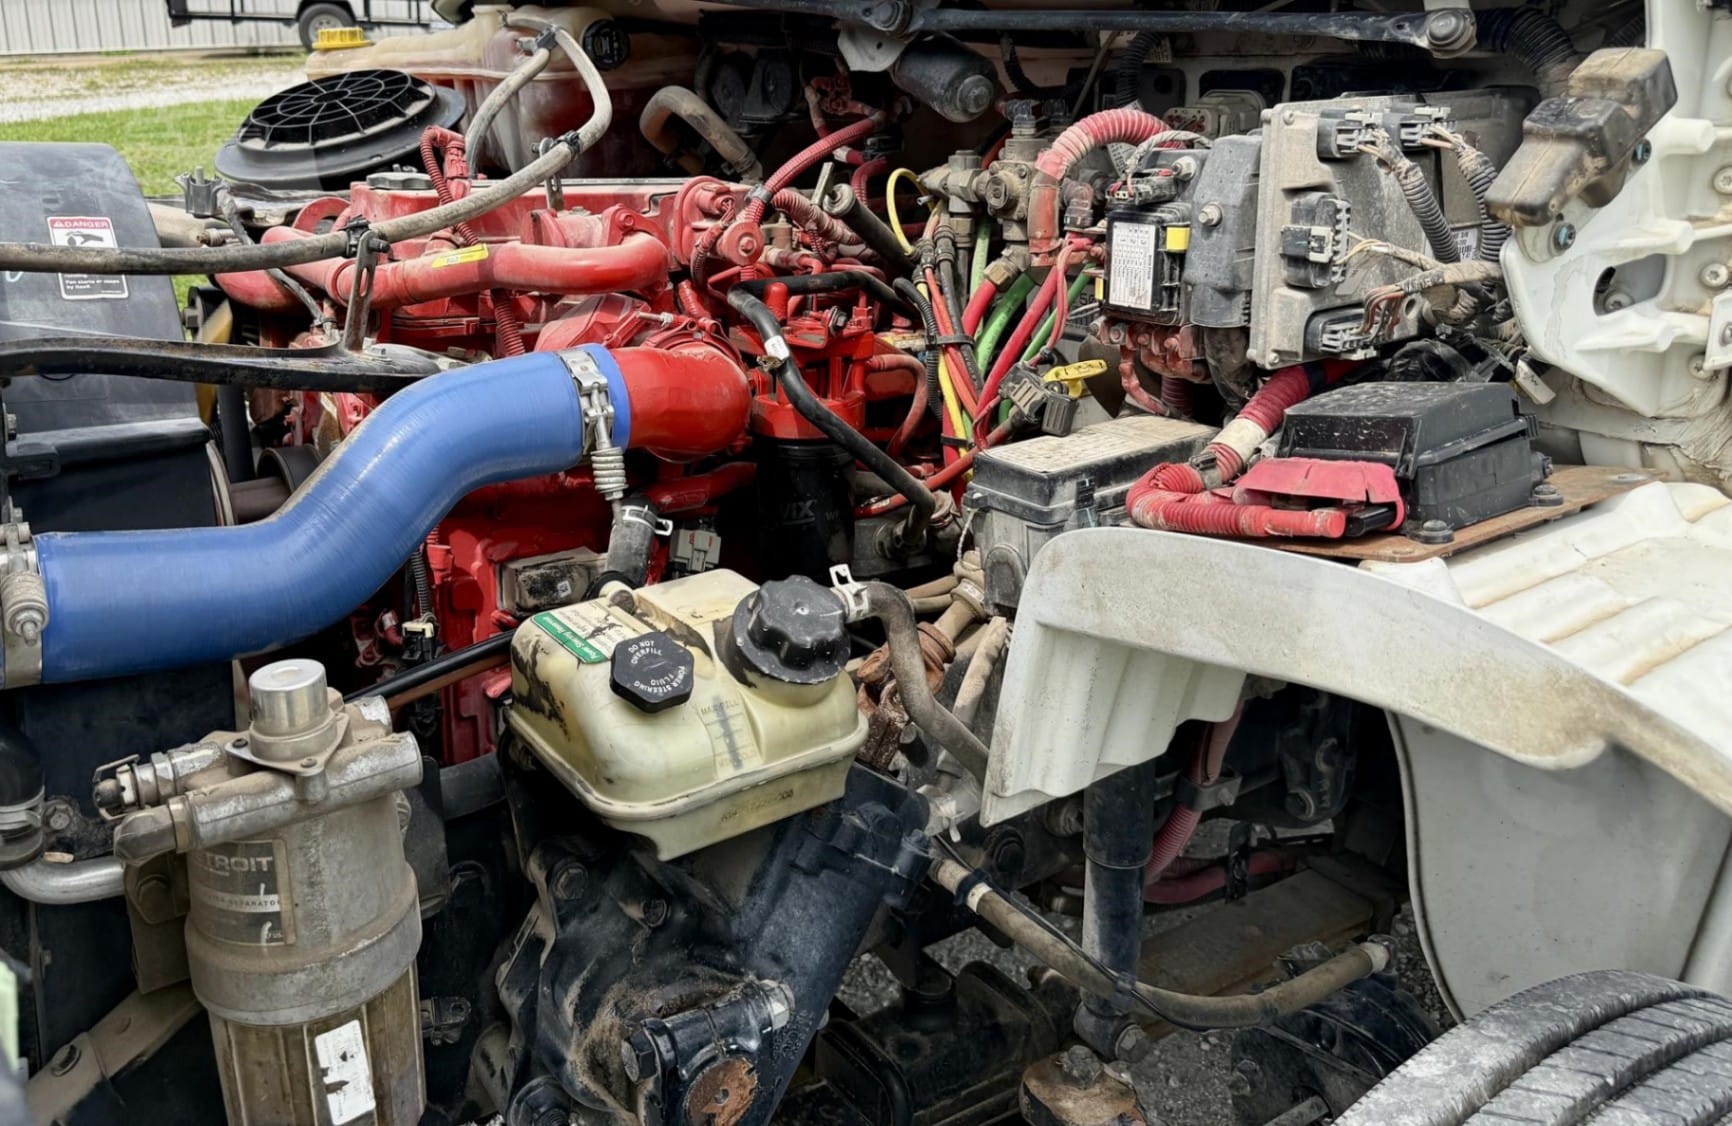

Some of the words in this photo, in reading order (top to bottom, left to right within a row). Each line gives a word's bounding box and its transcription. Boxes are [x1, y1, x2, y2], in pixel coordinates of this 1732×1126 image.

[64, 221, 109, 229] DANGER
[628, 644, 639, 654] DO
[630, 647, 662, 664] OVERFILL
[650, 672, 674, 686] FLUID
[670, 665, 686, 688] POWER
[633, 680, 672, 693] STEERING
